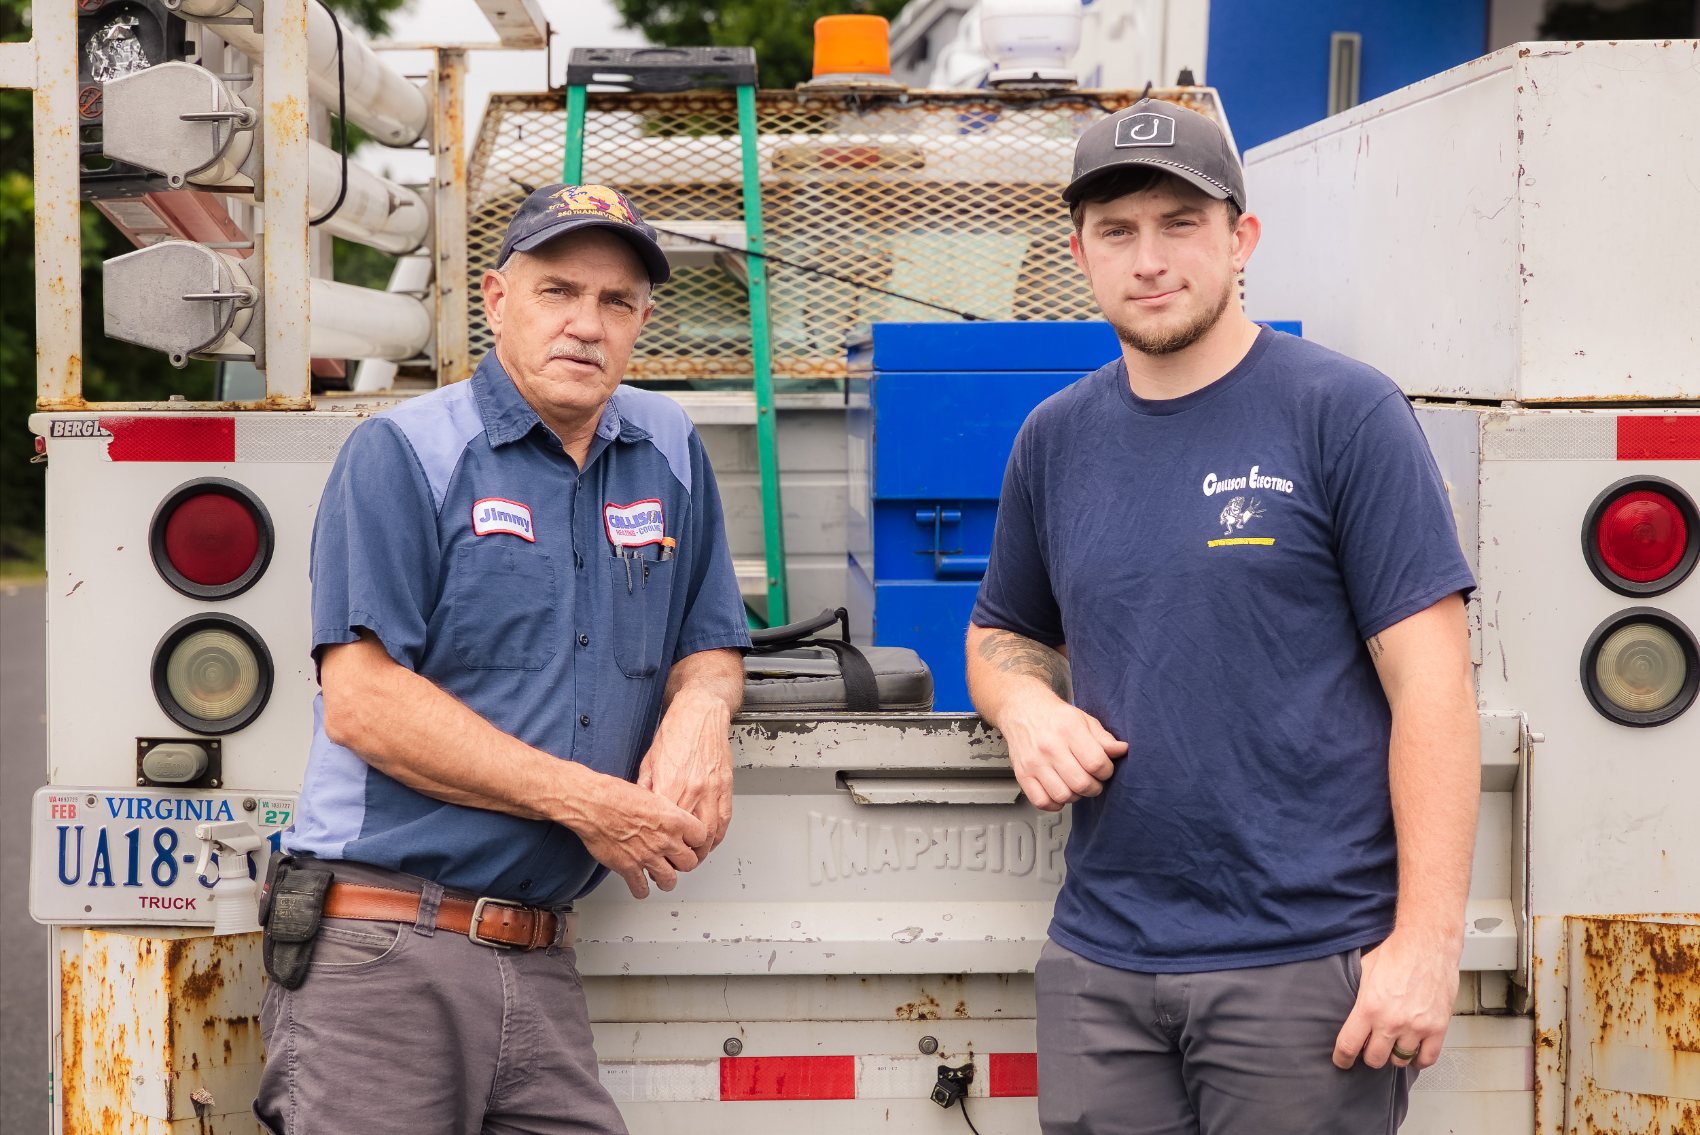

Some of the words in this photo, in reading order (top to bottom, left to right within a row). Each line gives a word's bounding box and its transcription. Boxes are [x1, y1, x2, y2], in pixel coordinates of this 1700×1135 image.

[479, 507, 530, 533] Jimmy
[51, 804, 77, 820] FEB
[105, 797, 234, 821] VIRGINIA
[265, 810, 290, 825] 27
[807, 810, 1063, 887] KNAPHEIDE
[139, 896, 196, 910] TRUCK
